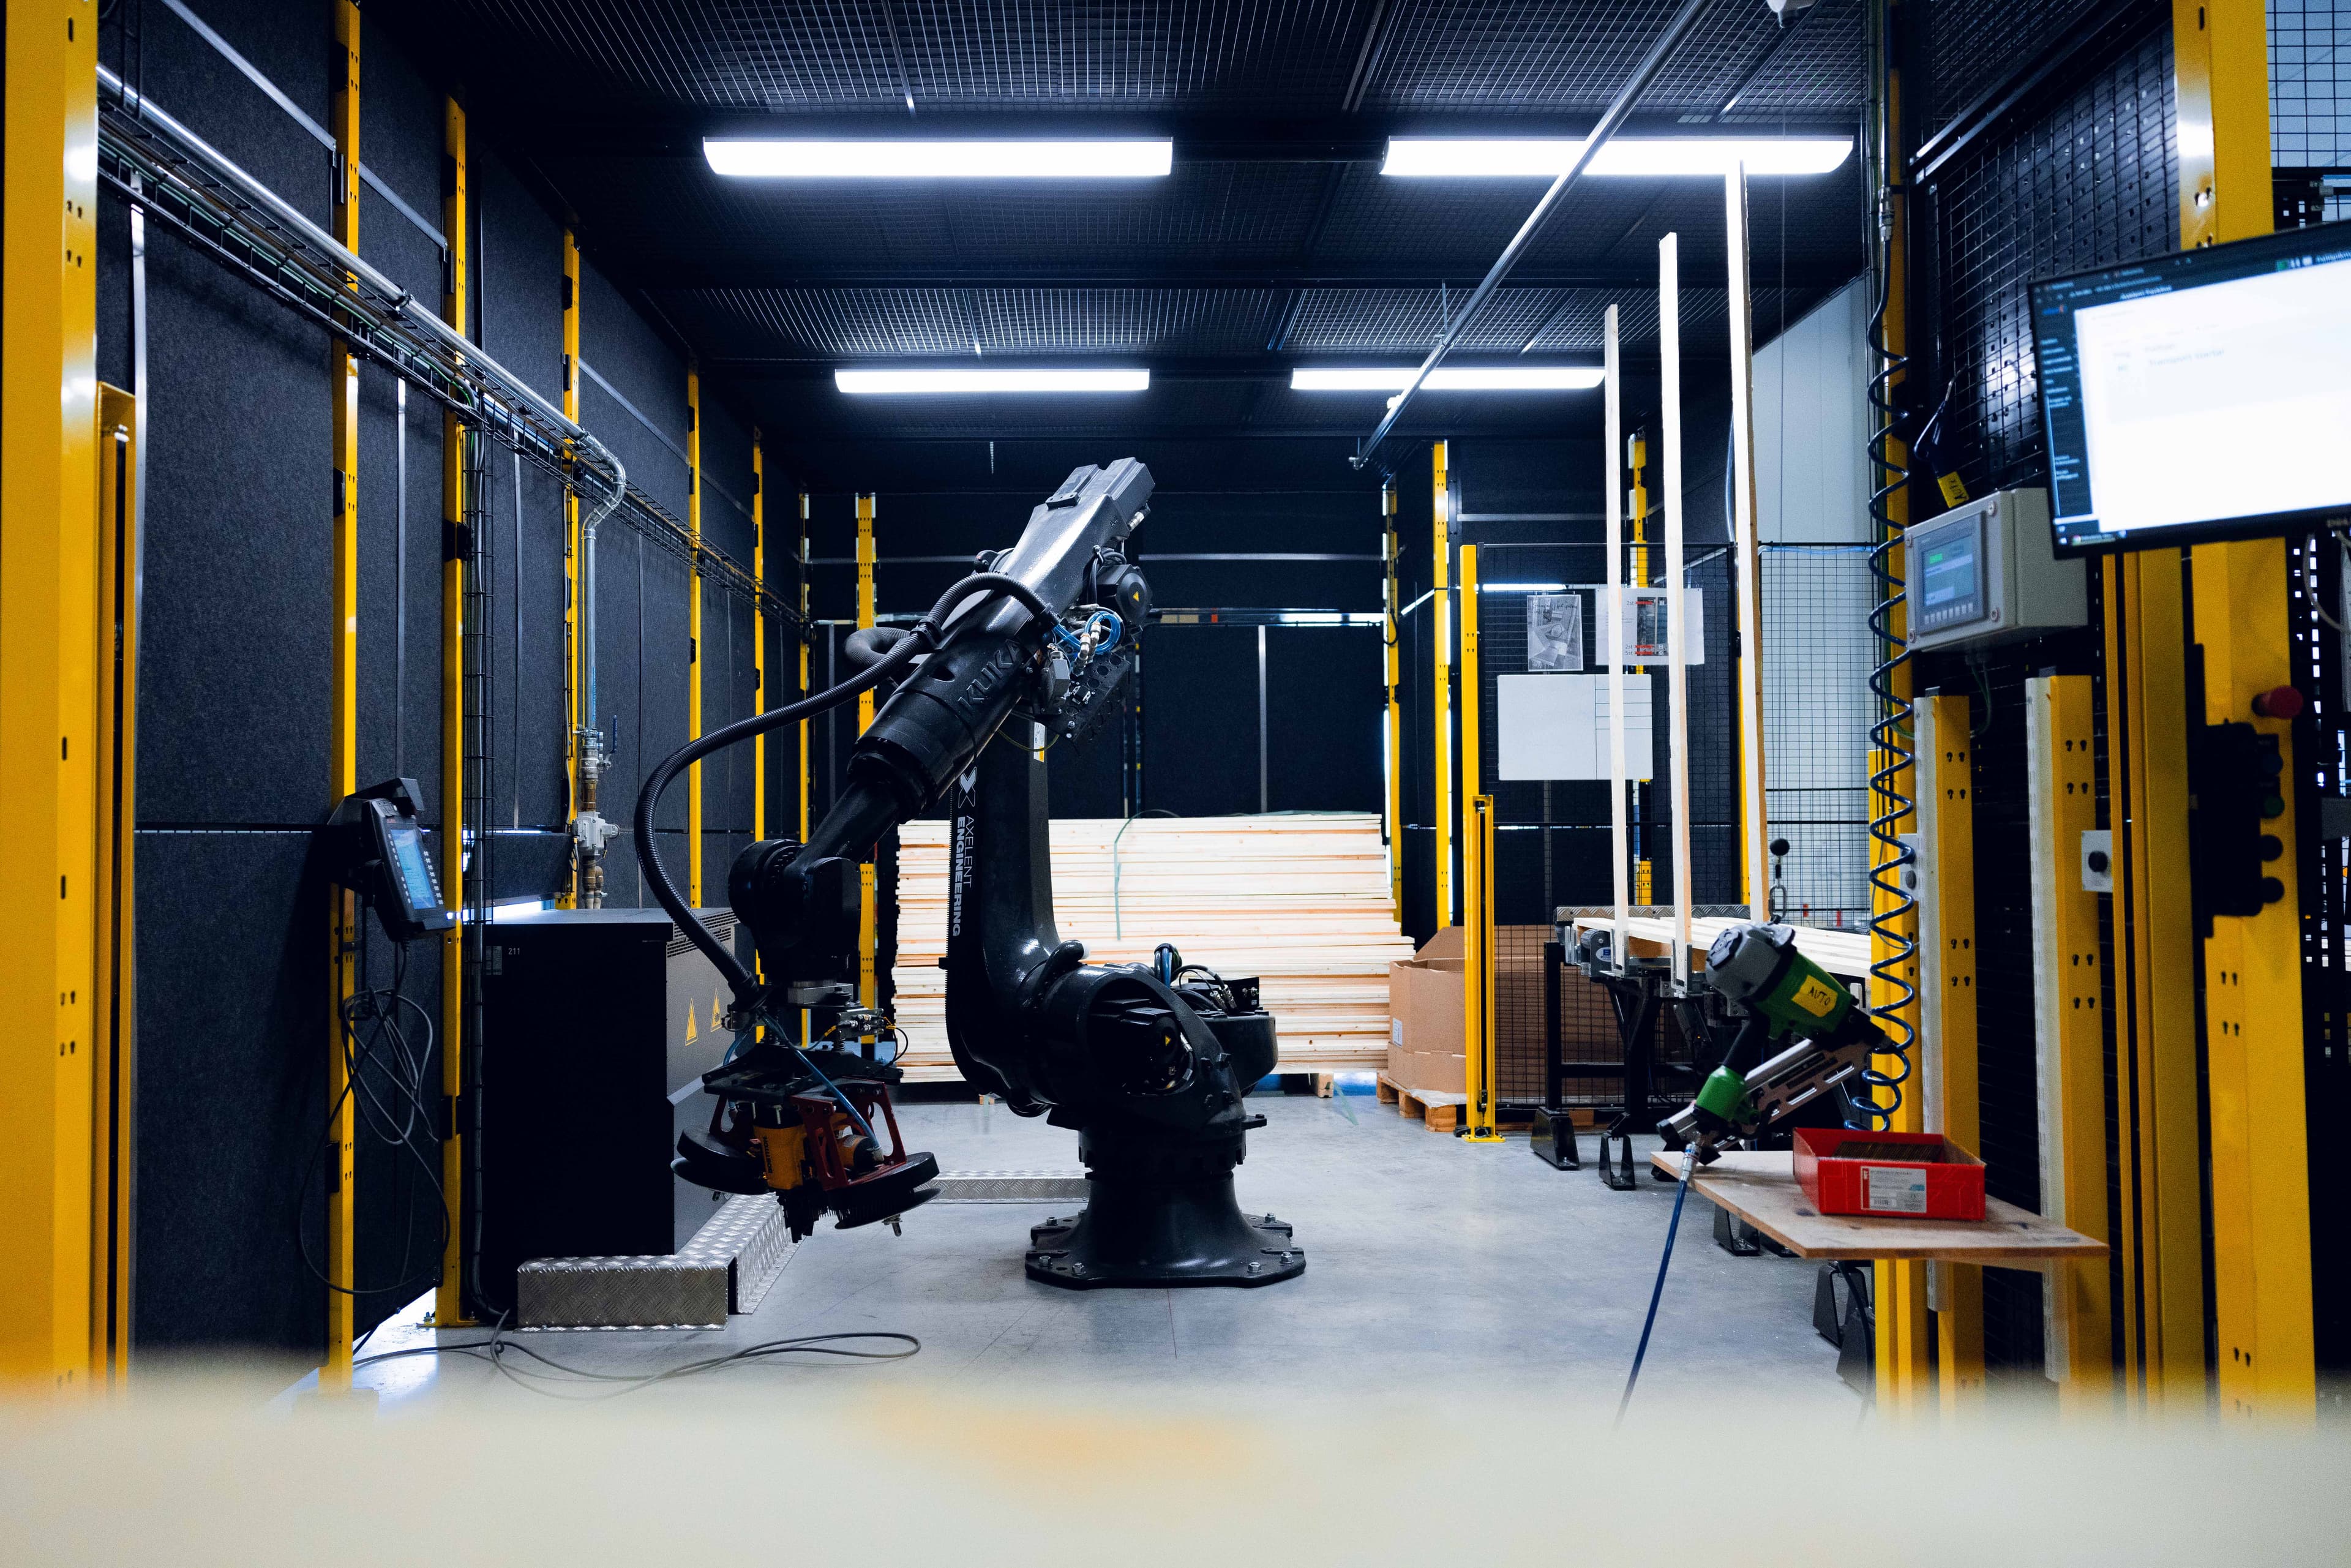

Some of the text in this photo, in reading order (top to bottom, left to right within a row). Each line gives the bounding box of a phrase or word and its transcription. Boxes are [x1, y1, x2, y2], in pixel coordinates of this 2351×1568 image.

[958, 639, 1021, 715] KUKA
[953, 816, 966, 937] ENGINEERING
[963, 815, 975, 888] AXELENT
[1810, 986, 1831, 1006] AUTO
